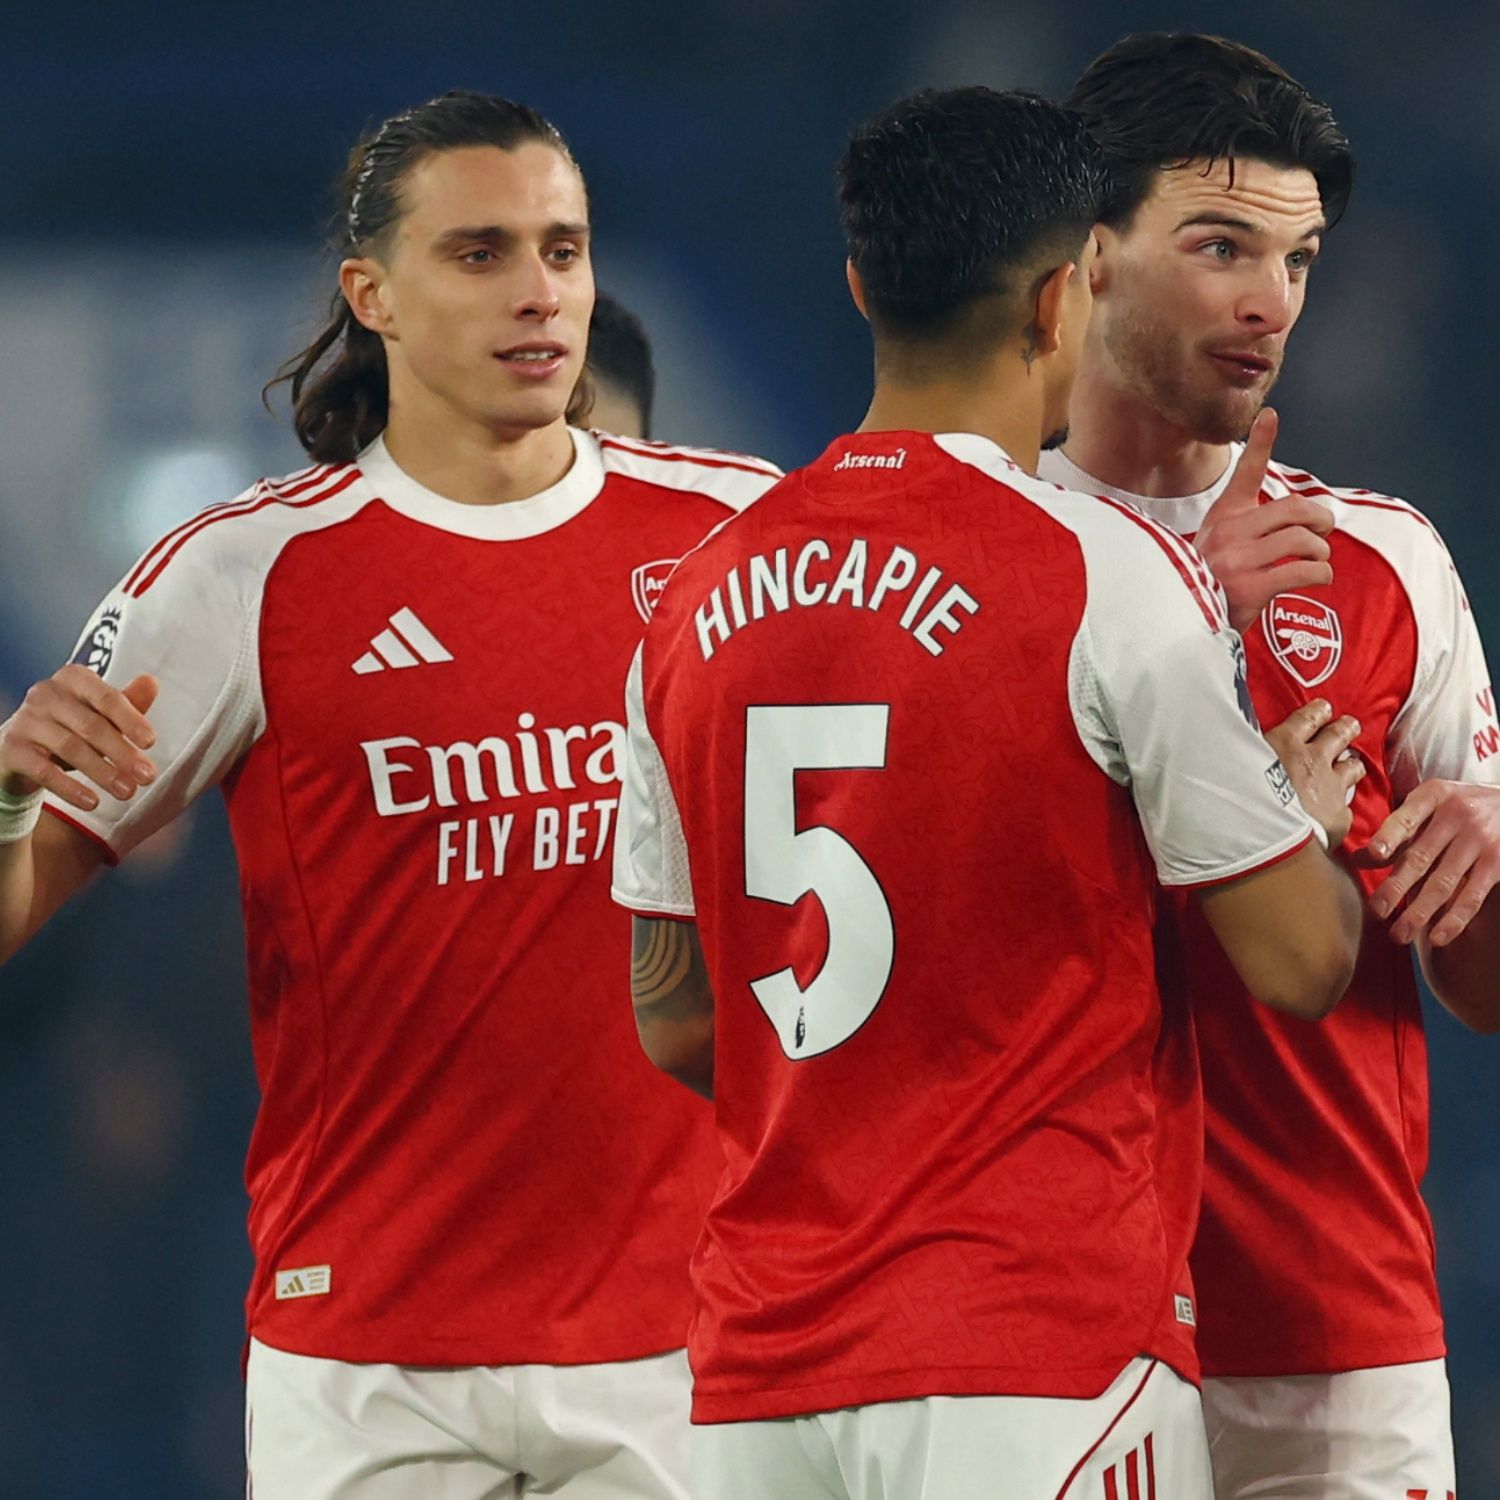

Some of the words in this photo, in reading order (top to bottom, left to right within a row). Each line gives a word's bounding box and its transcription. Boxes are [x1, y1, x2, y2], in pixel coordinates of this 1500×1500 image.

[833, 447, 907, 472] Arsenal
[694, 538, 979, 661] HINCAPIE
[1275, 607, 1330, 631] Arsenal
[437, 813, 514, 886] FLY
[743, 703, 895, 1061] 5
